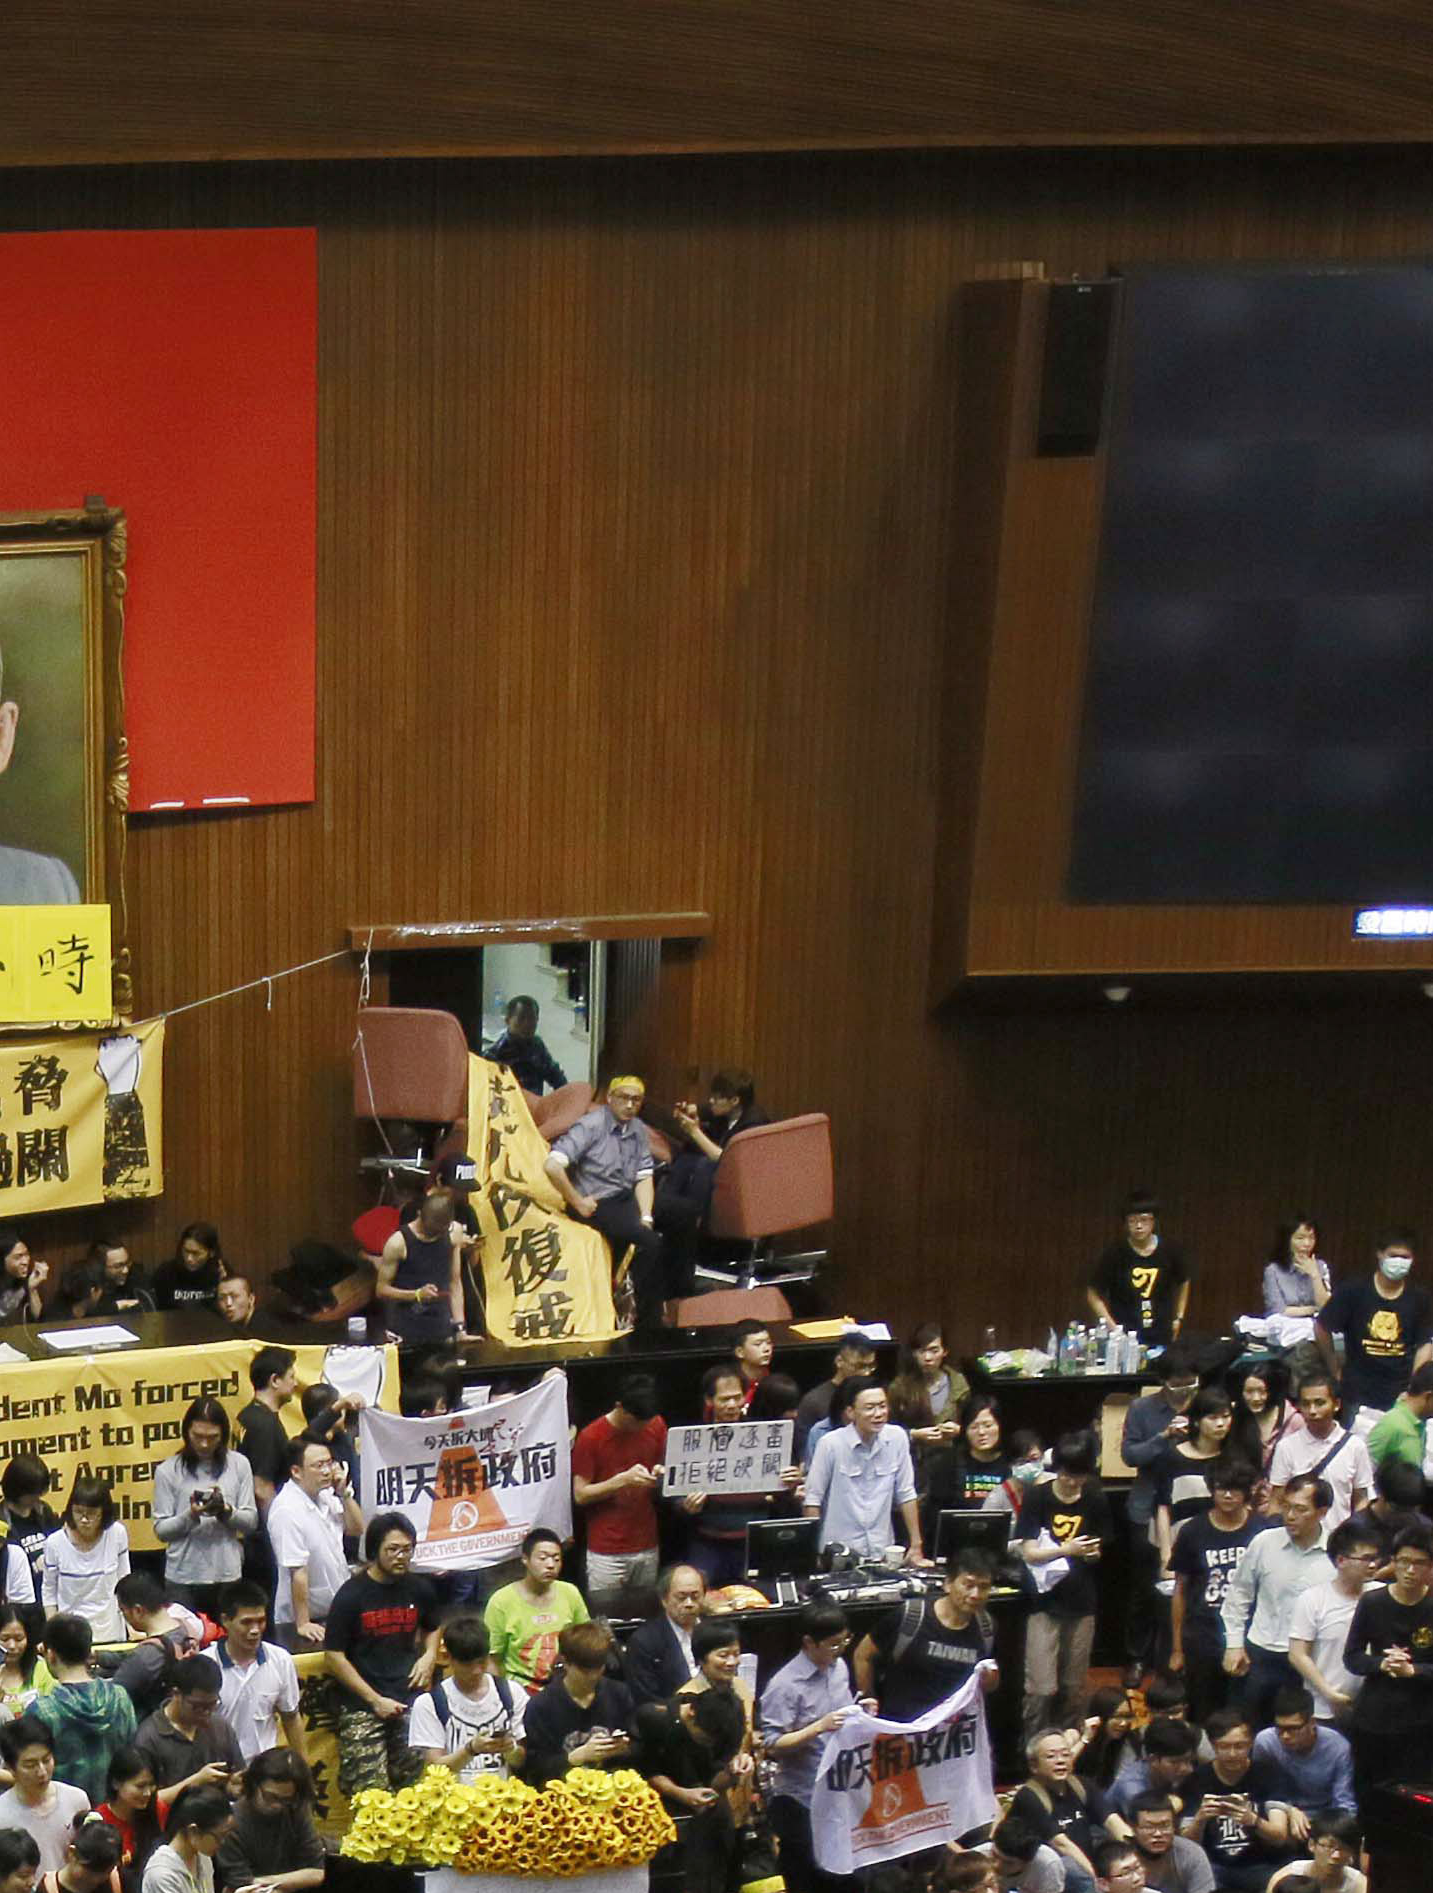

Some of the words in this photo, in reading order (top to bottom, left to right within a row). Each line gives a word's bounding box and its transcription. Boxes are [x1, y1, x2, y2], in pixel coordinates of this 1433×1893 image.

[74, 1382, 123, 1413] Ma
[130, 1370, 240, 1404] forced
[99, 1421, 136, 1447] to
[142, 1422, 182, 1449] pa
[76, 1457, 154, 1490] Agre
[376, 1442, 557, 1506] 明天拆政府
[416, 1544, 438, 1560] UCK
[438, 1541, 459, 1557] THE
